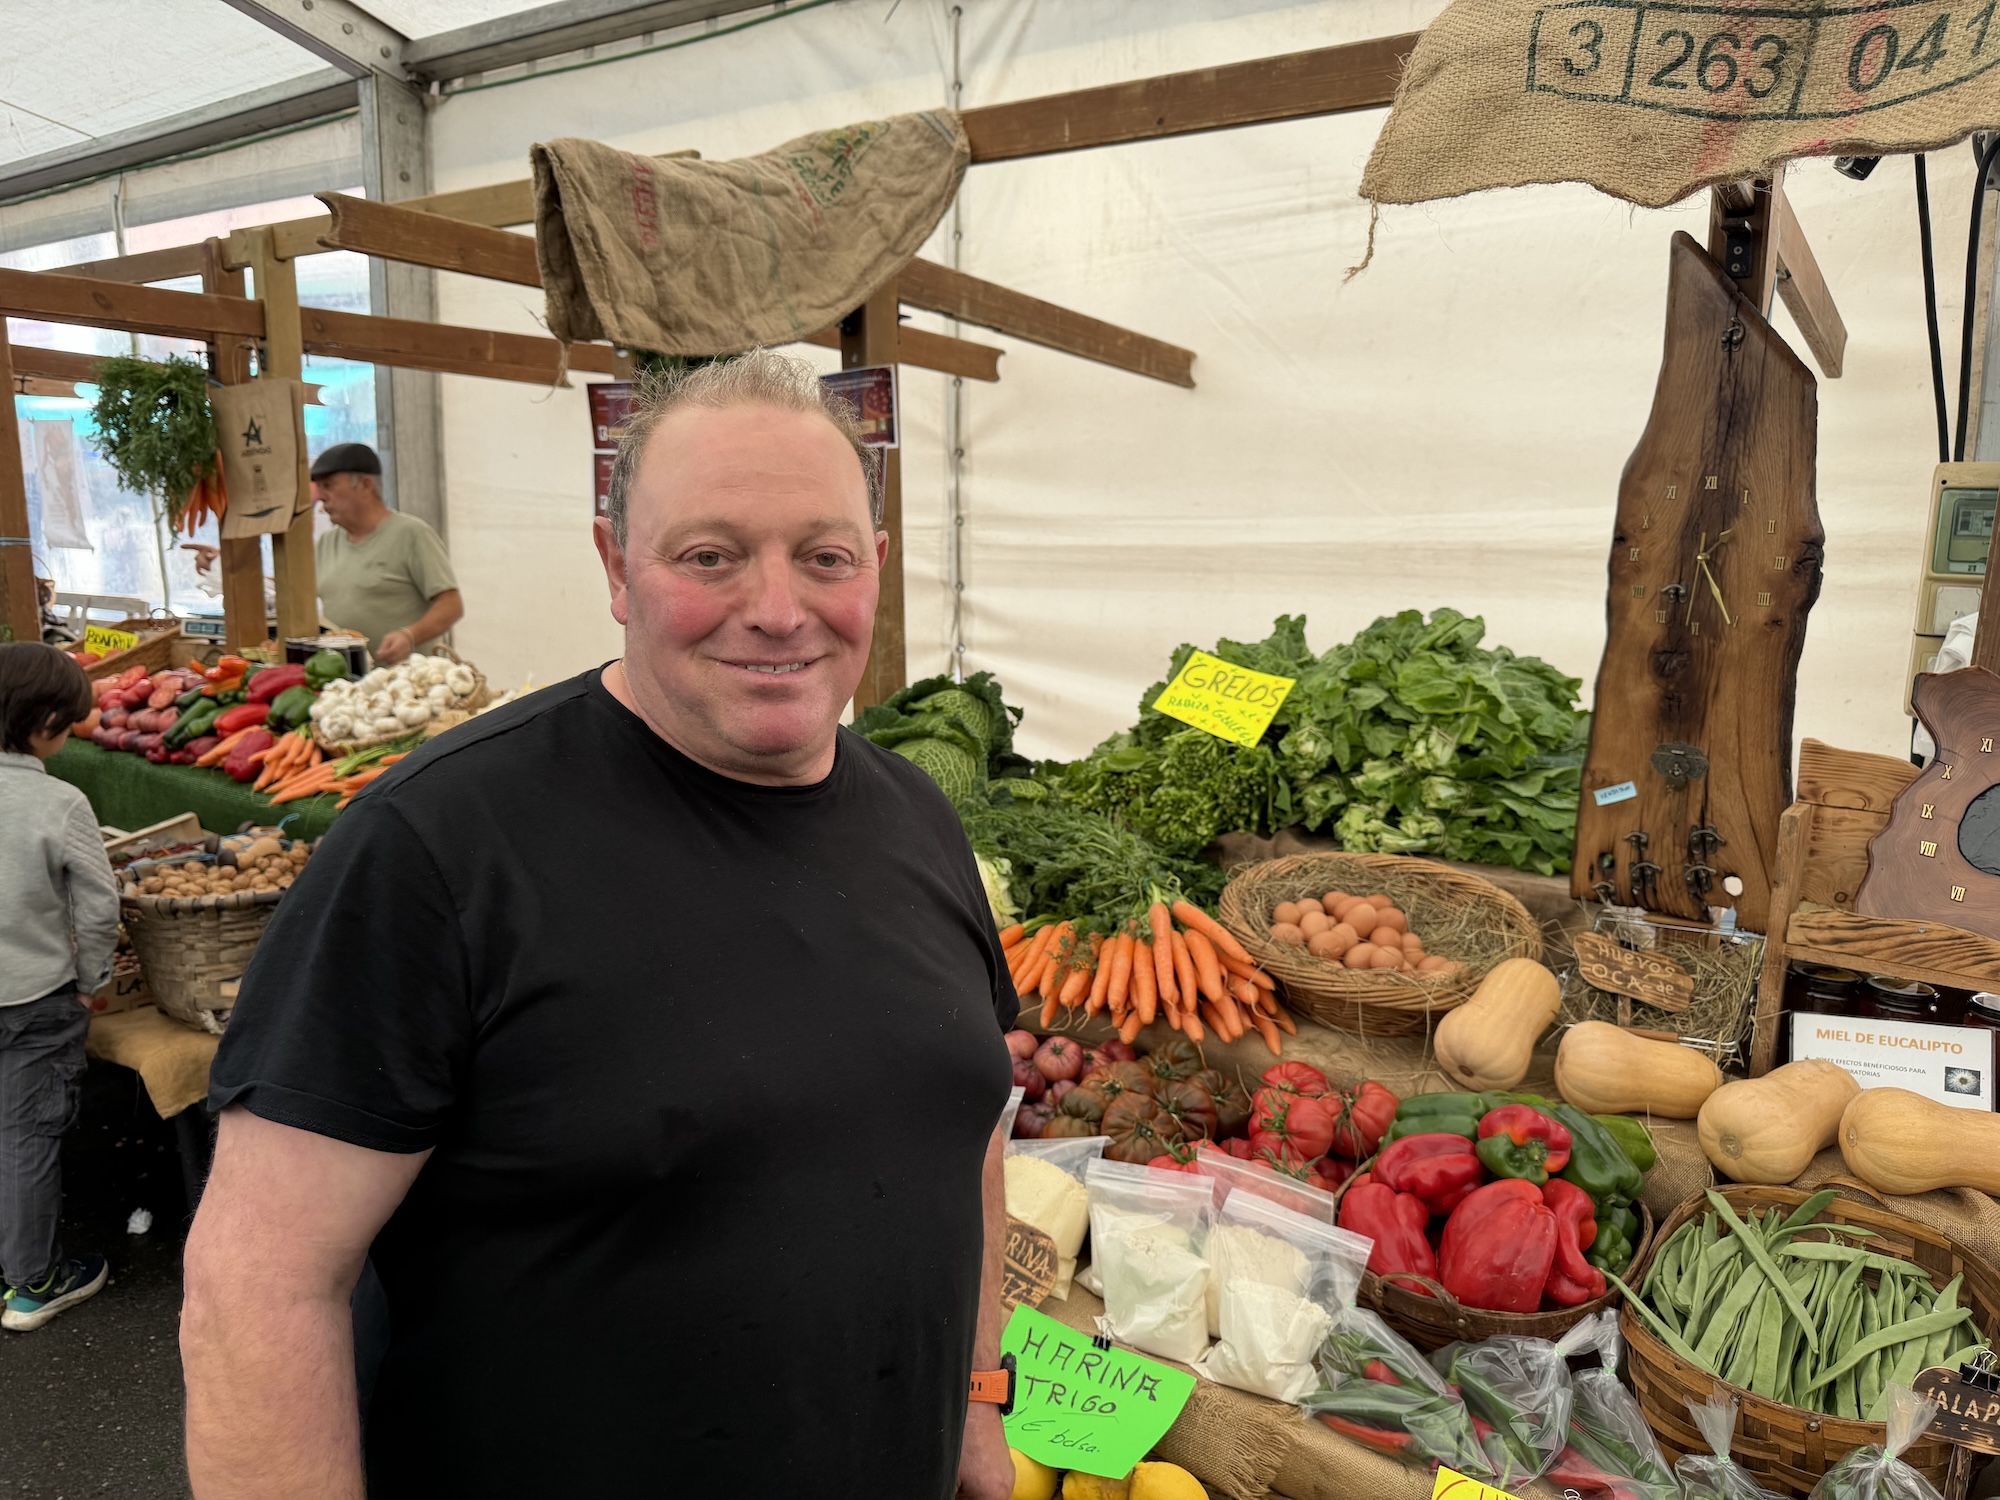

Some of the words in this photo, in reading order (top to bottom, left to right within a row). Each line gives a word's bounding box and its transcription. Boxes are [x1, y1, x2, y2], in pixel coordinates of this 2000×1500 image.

[1561, 19, 1603, 77] 3
[1648, 28, 1789, 98] 263
[1848, 1, 1997, 93] 041
[1705, 476, 1718, 490] XII
[1667, 486, 1676, 500] XI
[1642, 515, 1649, 529] X
[1768, 520, 1775, 534] II
[1630, 548, 1640, 562] IX
[1774, 557, 1785, 571] III
[1757, 592, 1771, 606] IIII
[1655, 610, 1667, 624] VII
[1691, 622, 1700, 636] VI
[1182, 663, 1286, 708] GRELOS
[1980, 737, 1994, 753] XI
[1941, 764, 1953, 780] X
[1921, 803, 1935, 820] IX
[1920, 840, 1938, 858] VIII
[1950, 885, 1966, 902] VII
[1816, 1027, 1851, 1042] MIEL
[1855, 1031, 1874, 1045] DE
[1879, 1034, 1963, 1055] EUCALIPTO
[1836, 1058, 1862, 1067] EFECTOS
[1863, 1061, 1908, 1073] BENEFICIOSOS
[1908, 1066, 1927, 1075] PARA
[1849, 1069, 1881, 1078] RATORIAS
[1005, 1232, 1052, 1278] RINA
[1020, 1326, 1162, 1401] HARINA
[1024, 1375, 1117, 1414] TRIGO
